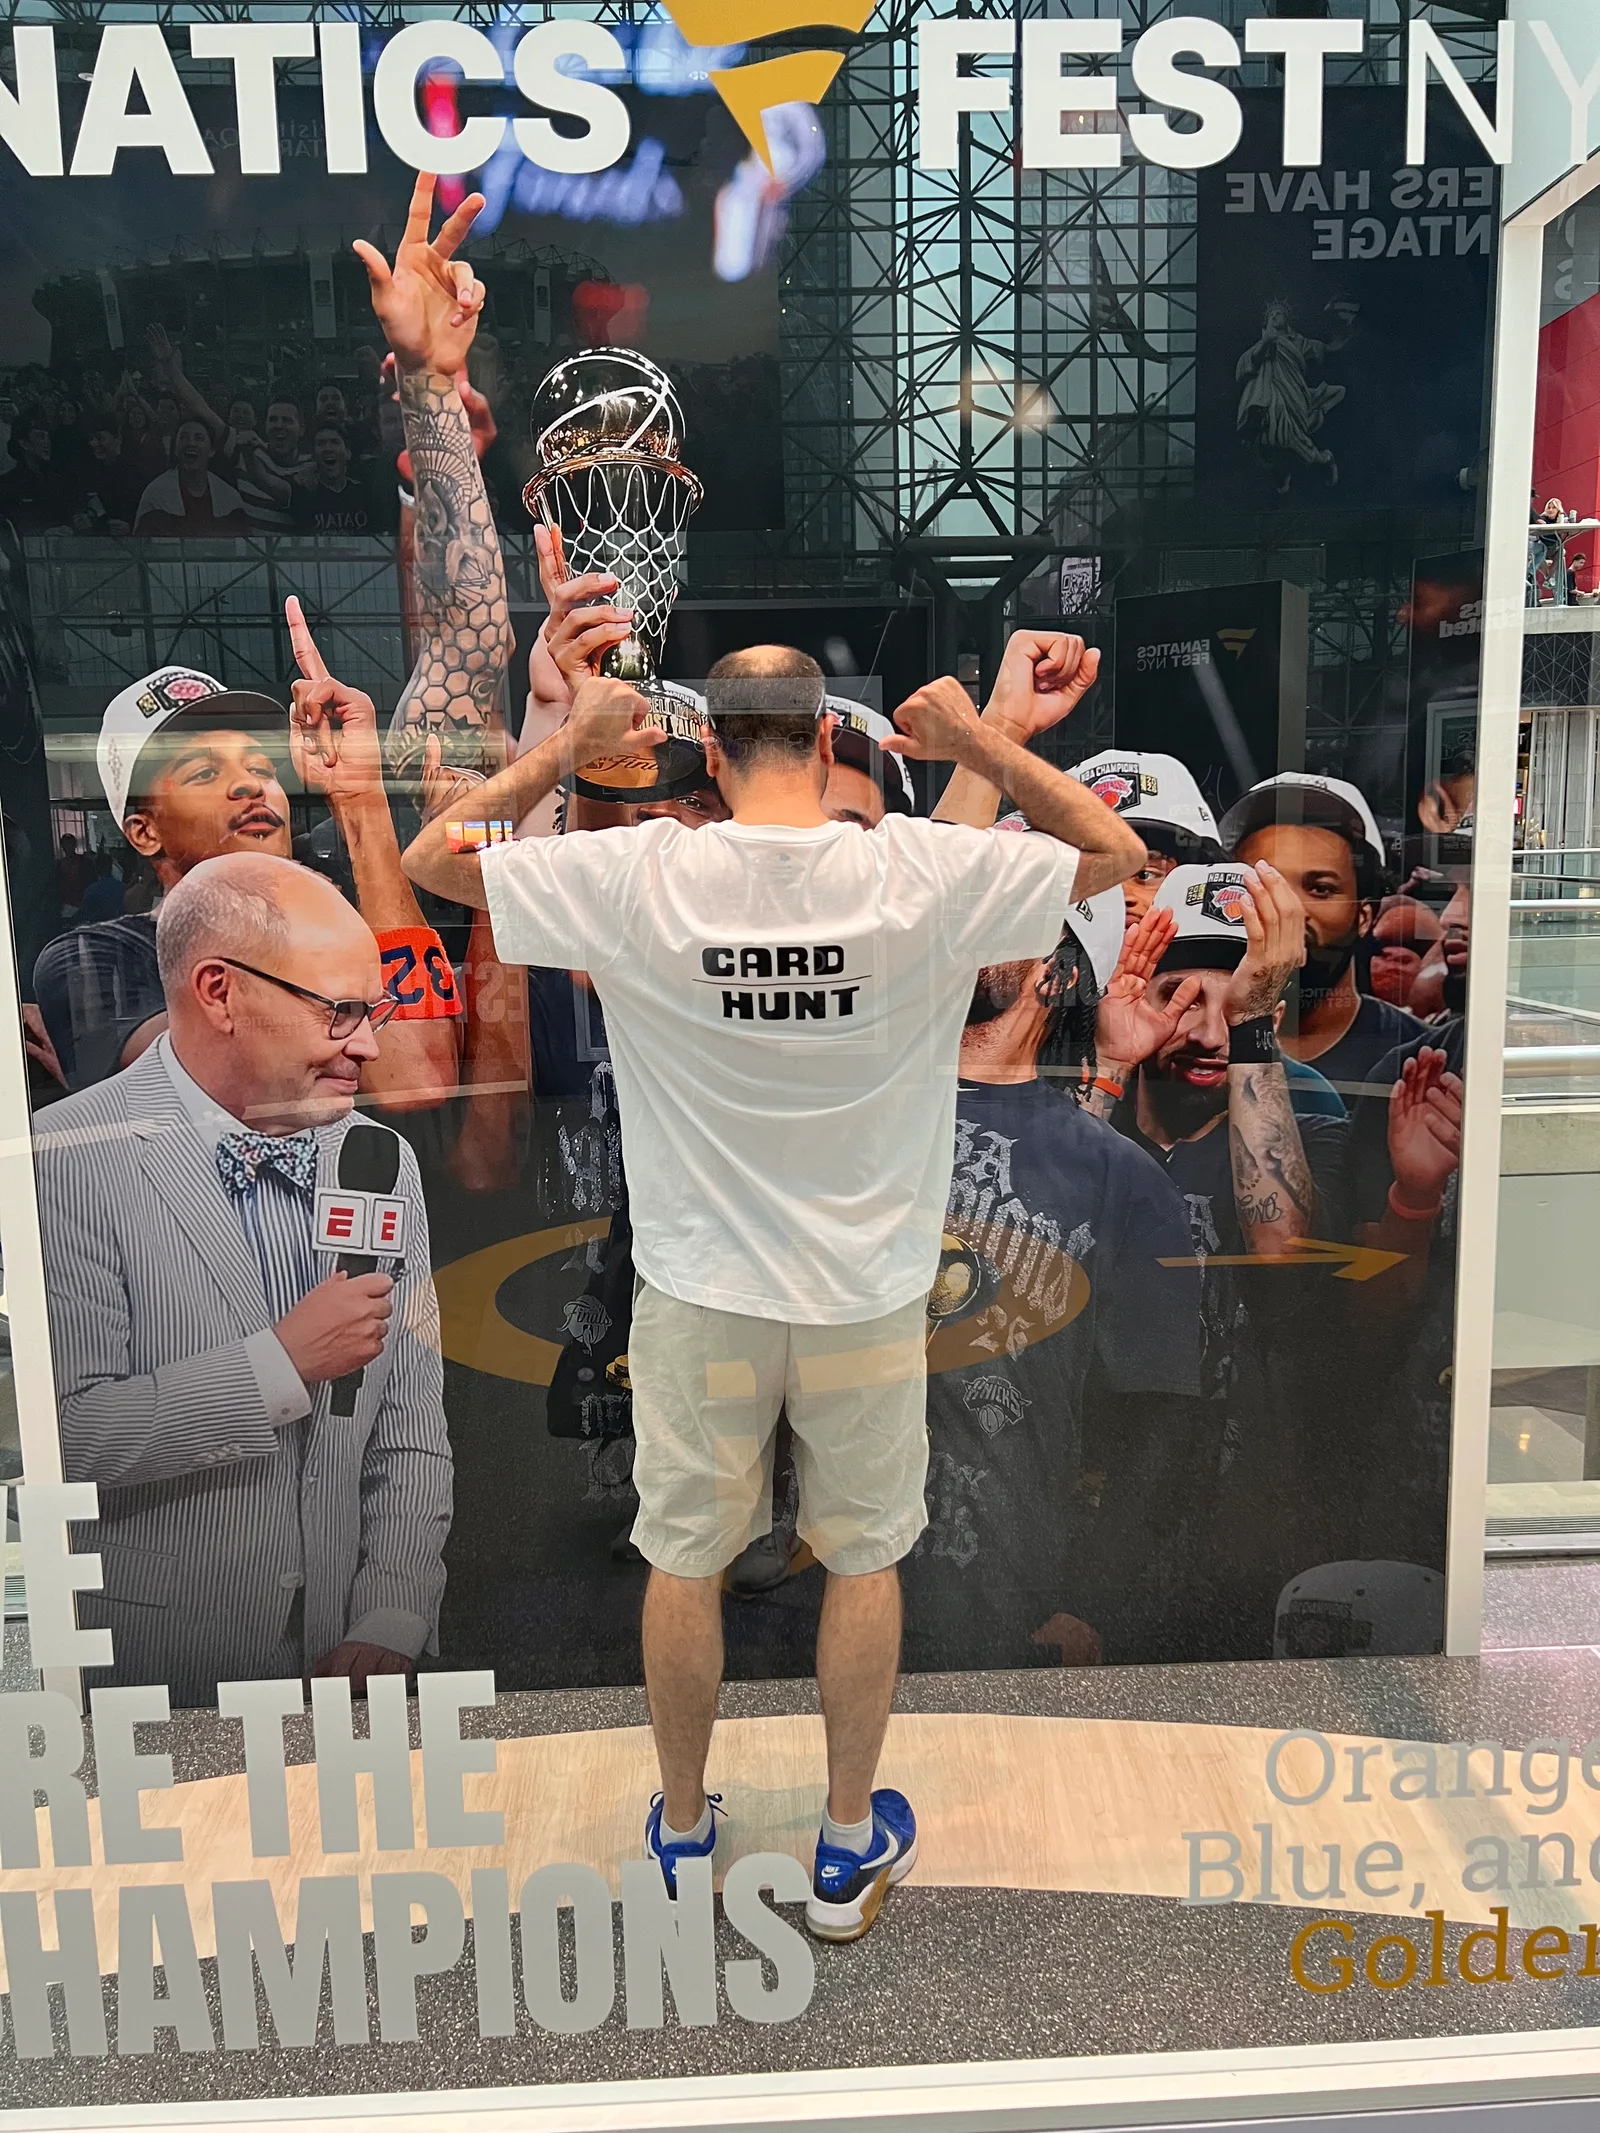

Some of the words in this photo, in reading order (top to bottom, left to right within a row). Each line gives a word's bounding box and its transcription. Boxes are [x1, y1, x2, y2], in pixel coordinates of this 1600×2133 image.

[917, 16, 1364, 169] FEST
[1095, 762, 1140, 777] CHAMPIONS
[702, 945, 844, 977] CARD
[721, 985, 860, 1020] HUNT
[217, 1669, 505, 1858] THE
[1181, 1822, 1426, 1910] Blue,
[1461, 1828, 1600, 1894] an
[0, 1852, 815, 2059] HAMPIONS
